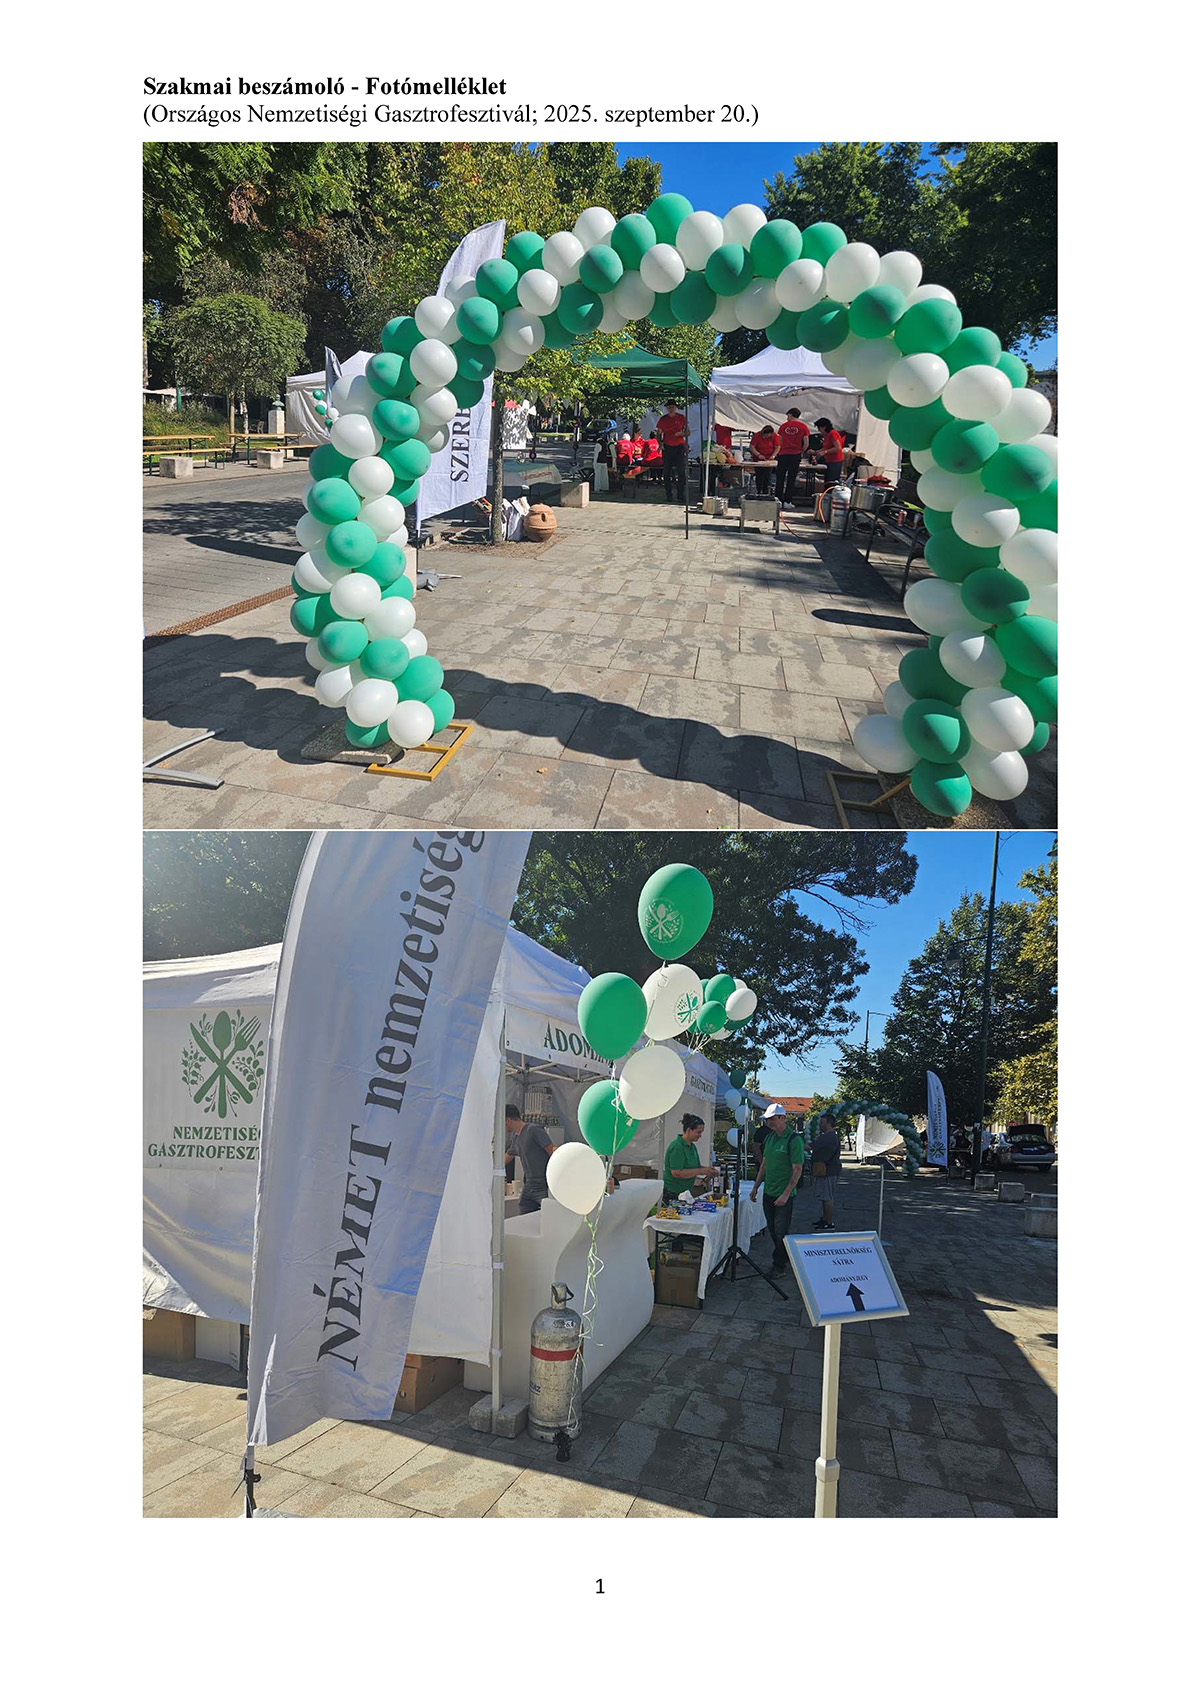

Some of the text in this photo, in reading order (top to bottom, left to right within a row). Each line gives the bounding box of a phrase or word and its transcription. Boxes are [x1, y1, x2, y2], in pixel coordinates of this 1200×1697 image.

[143, 76, 232, 96] Szakmai
[238, 76, 345, 96] beszámoló
[365, 76, 507, 96] Fotómelléklet
[143, 103, 759, 128] (Országos Nemzetiségi Gasztrofesztivál; 2025. szeptember 20.)
[173, 1124, 262, 1141] NEMZETISÉ
[312, 1124, 392, 1372] NÉMET
[595, 1578, 606, 1594] 1
